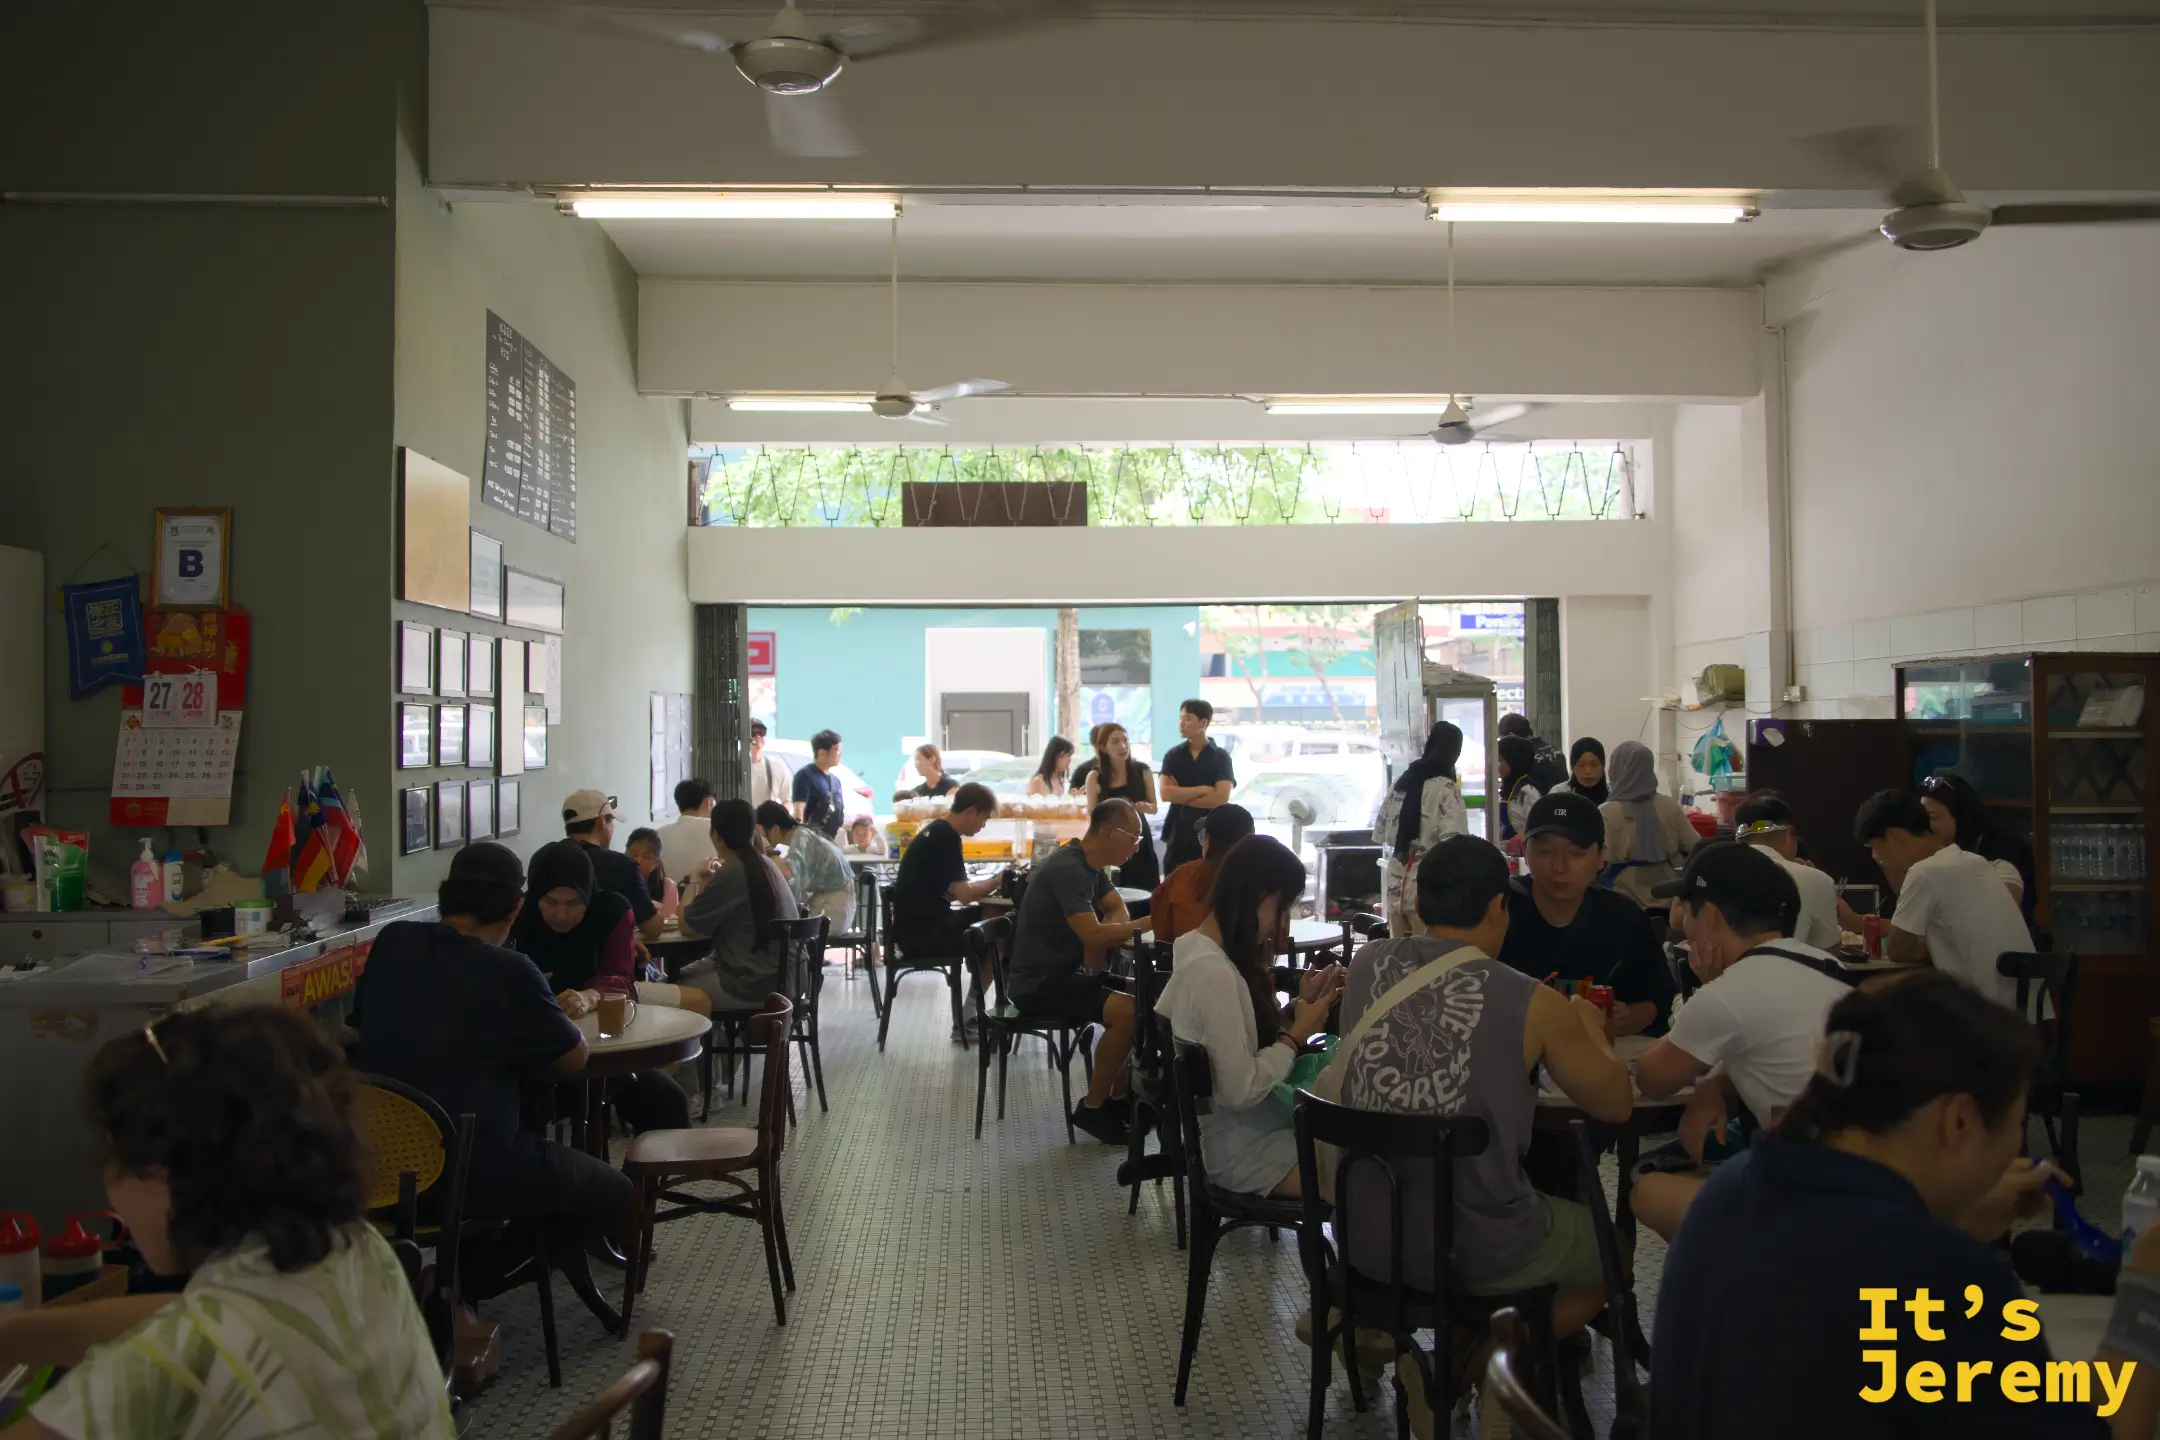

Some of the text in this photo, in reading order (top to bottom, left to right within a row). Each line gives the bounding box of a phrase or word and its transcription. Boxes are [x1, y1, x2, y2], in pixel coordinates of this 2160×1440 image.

[179, 549, 203, 577] B
[150, 682, 204, 709] 27 28
[303, 958, 353, 1004] AWAS!
[1440, 976, 1484, 1041] CUTE
[1373, 1066, 1458, 1109] CARE
